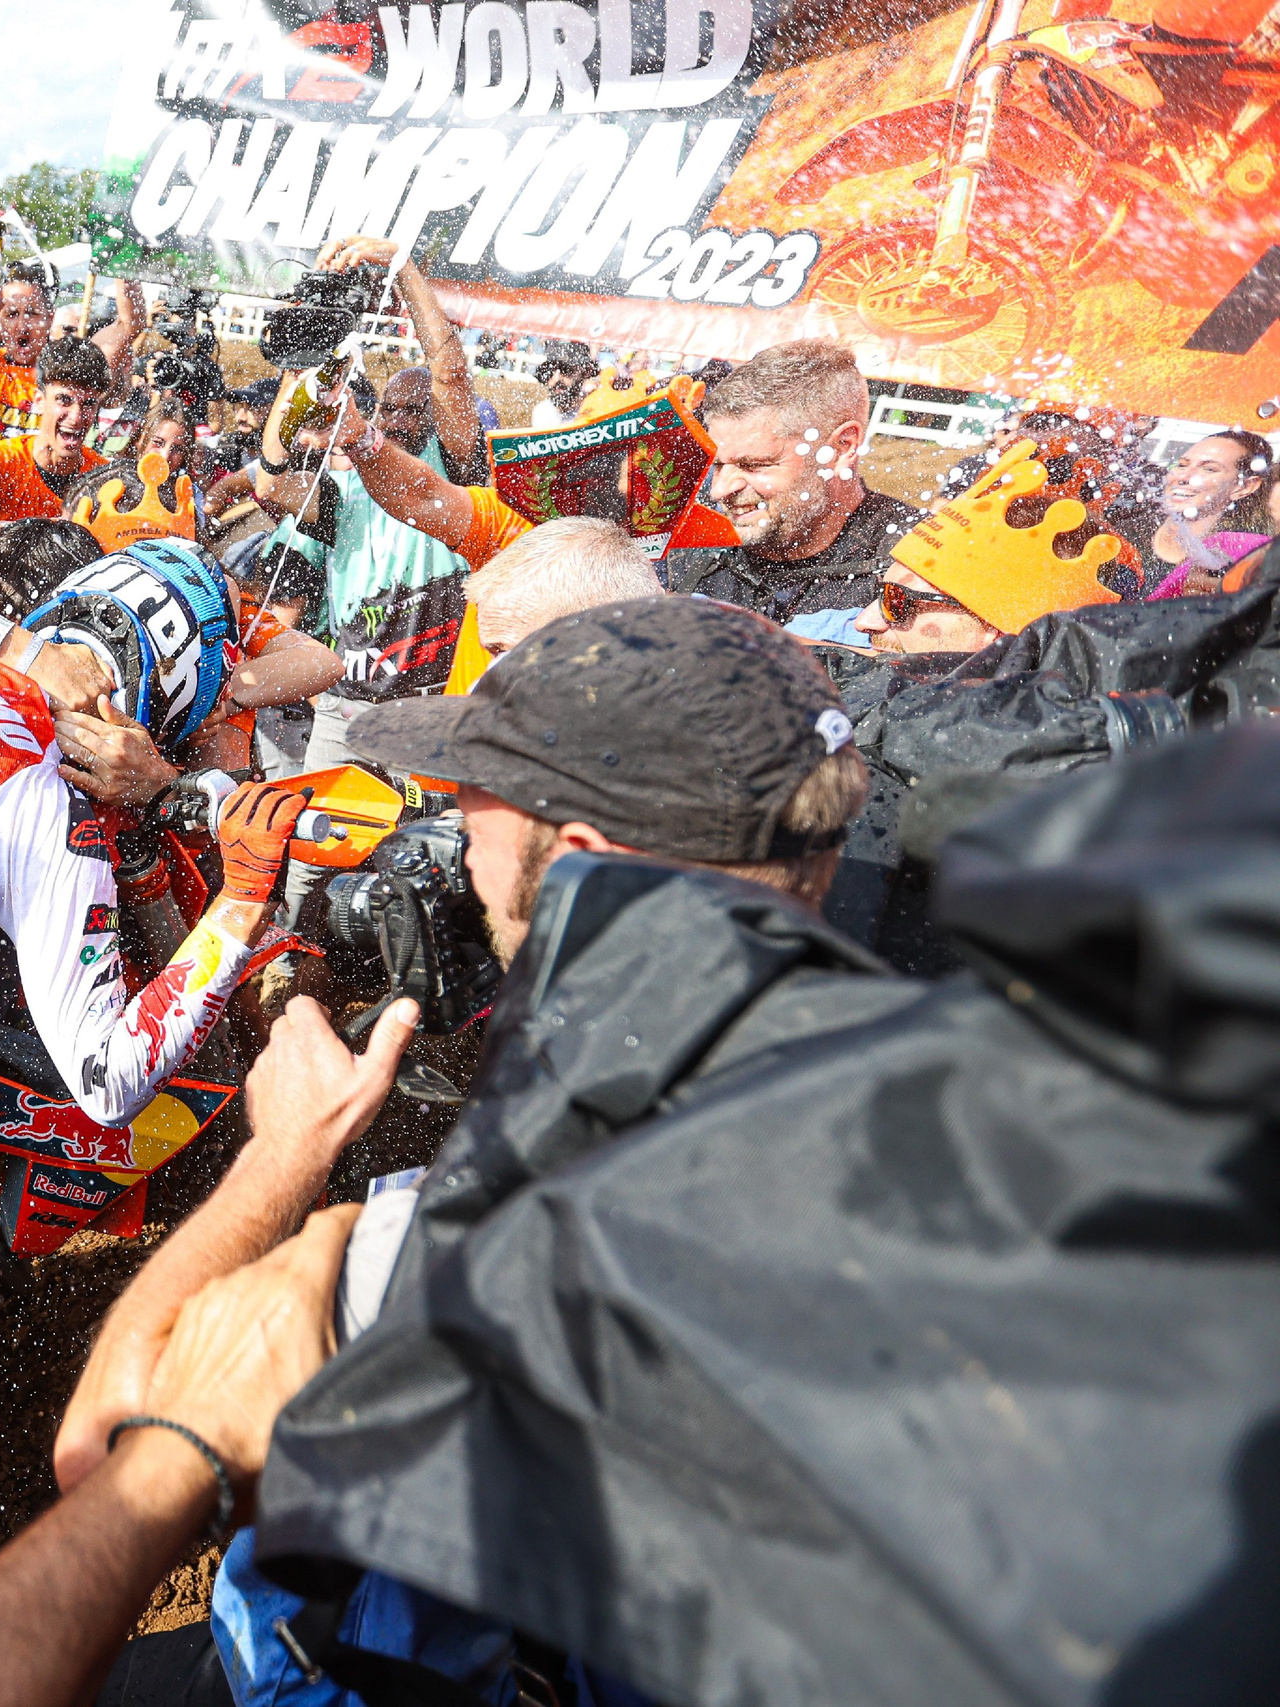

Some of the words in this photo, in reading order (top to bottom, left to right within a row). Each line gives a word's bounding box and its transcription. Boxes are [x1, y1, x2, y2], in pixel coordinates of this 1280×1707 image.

[367, 0, 753, 119] WORLD
[131, 115, 744, 281] CHAMPION
[628, 226, 819, 307] 2023
[520, 424, 614, 459] MOTOREX
[115, 527, 162, 538] ANDREA
[27, 1211, 79, 1229] KTM
